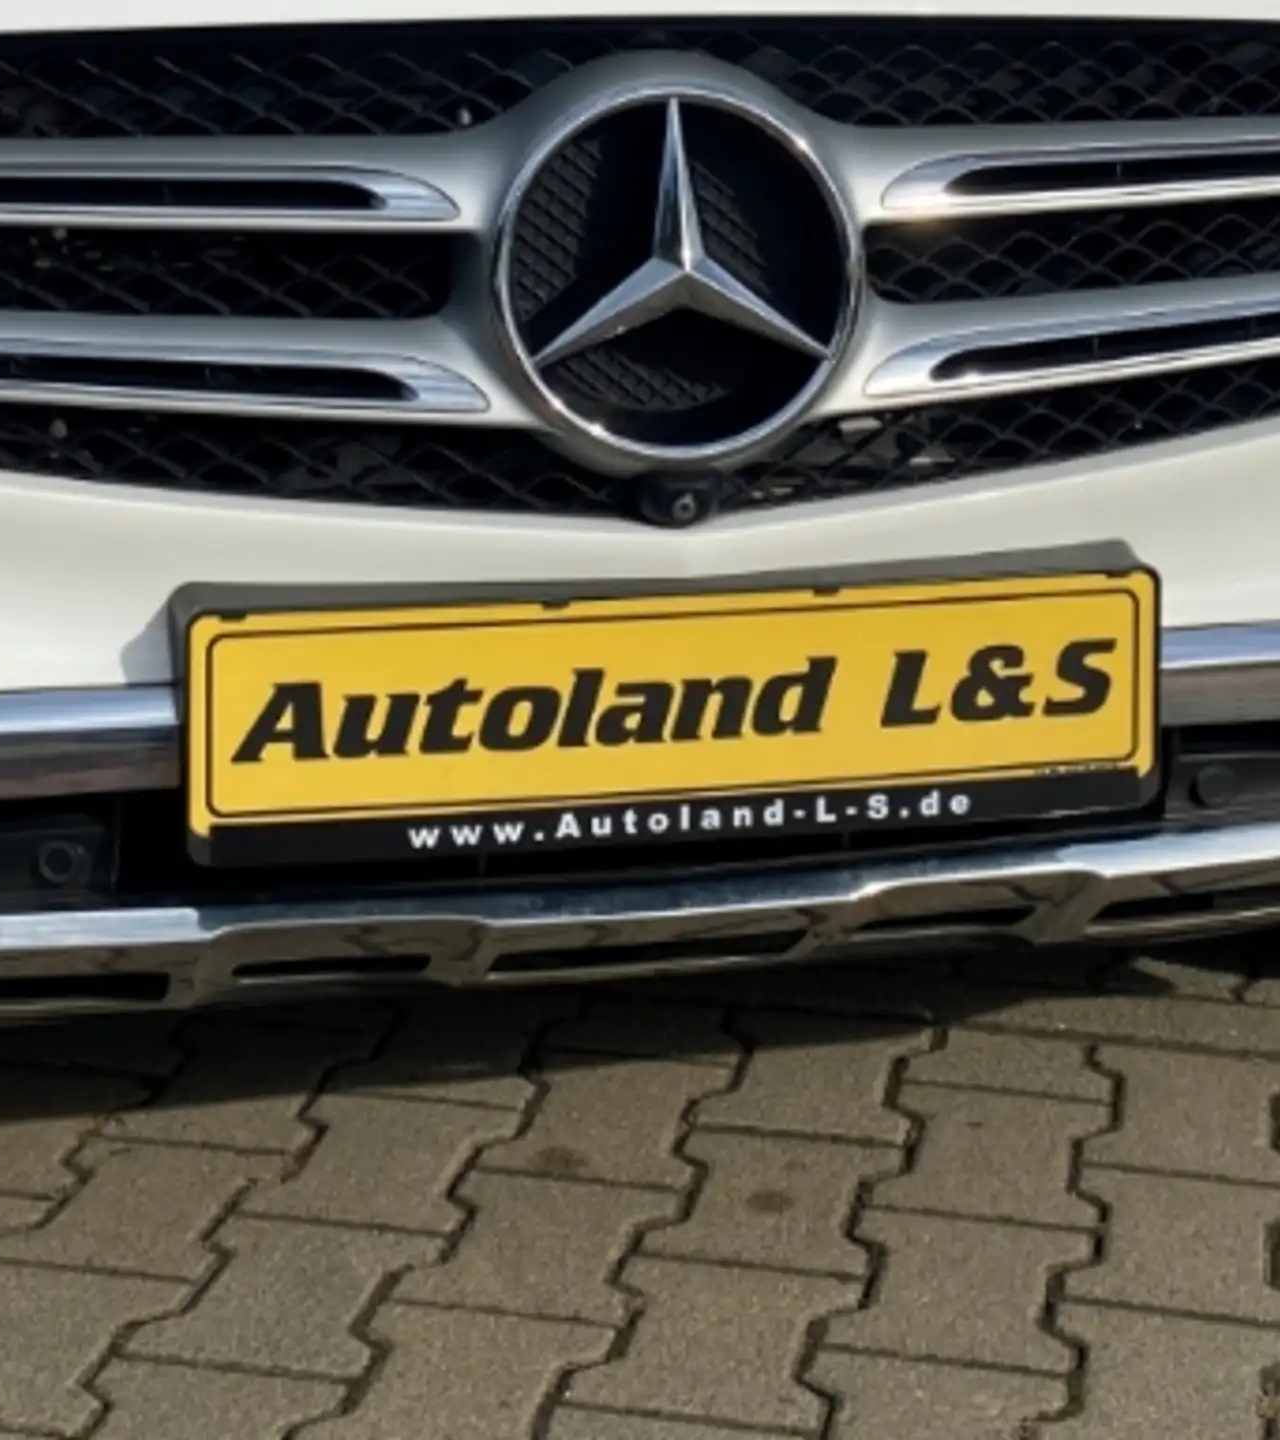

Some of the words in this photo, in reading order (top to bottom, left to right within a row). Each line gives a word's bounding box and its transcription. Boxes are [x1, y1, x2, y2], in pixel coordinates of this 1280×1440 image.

[230, 655, 838, 764] Autoland
[879, 637, 1118, 728] L&S
[407, 789, 972, 850] www.Autoland-L-S.de
